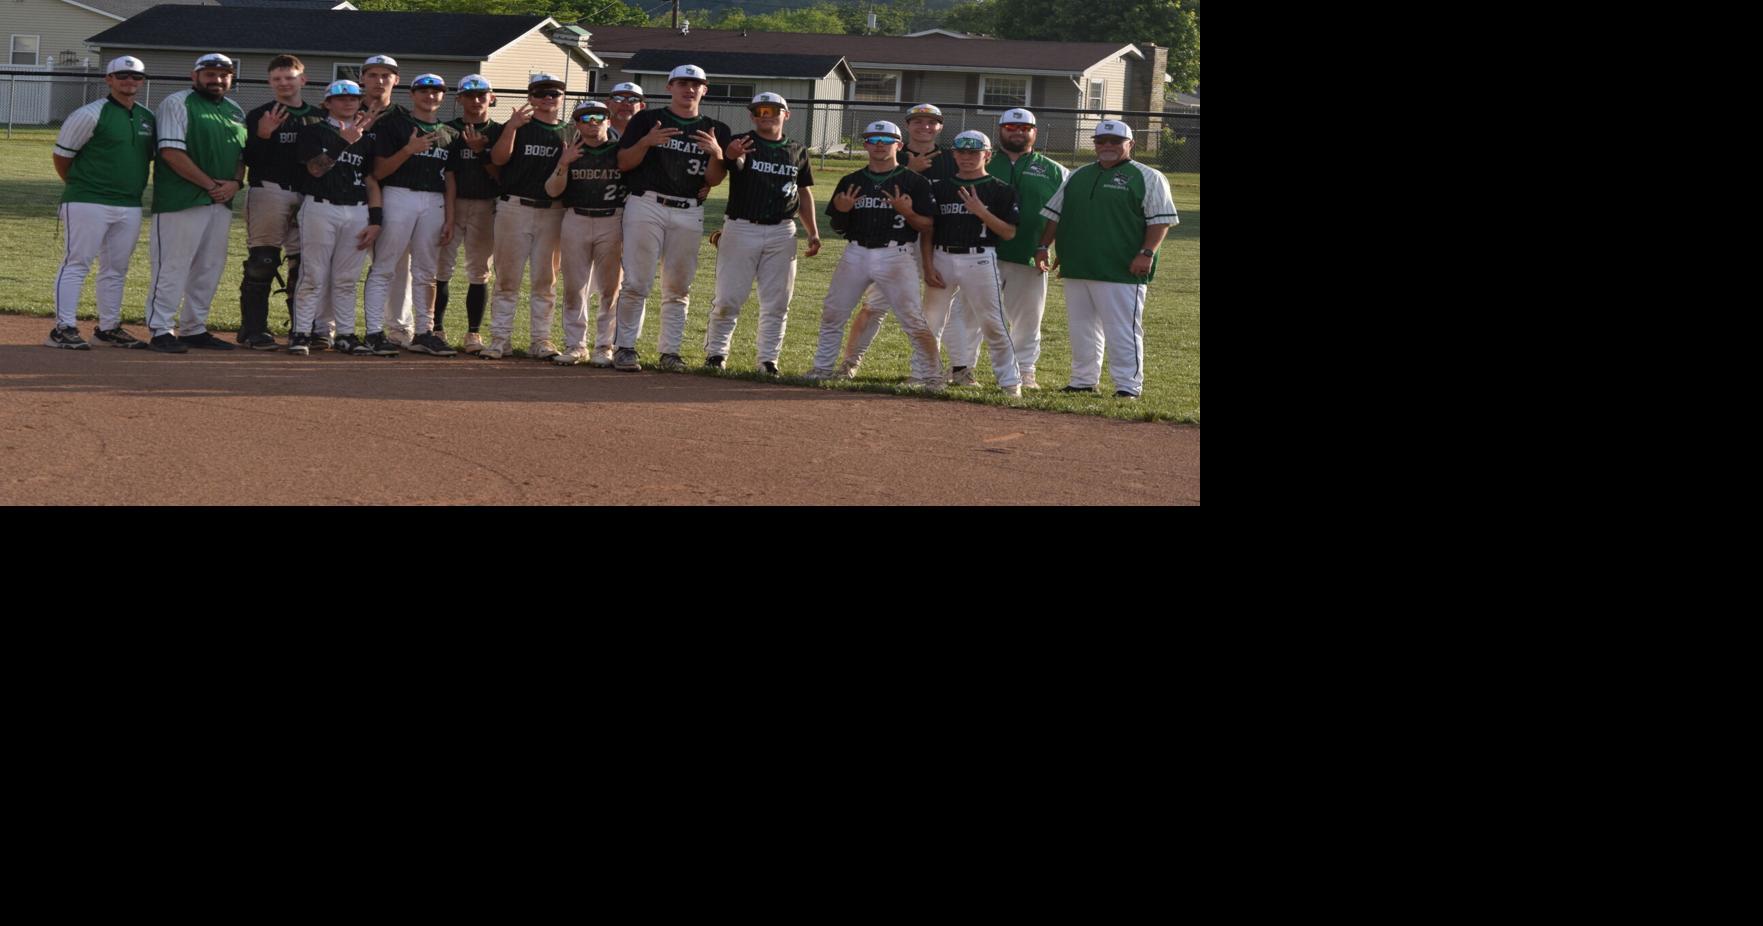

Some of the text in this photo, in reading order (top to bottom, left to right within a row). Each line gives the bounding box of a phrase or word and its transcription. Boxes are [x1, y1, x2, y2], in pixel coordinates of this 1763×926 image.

[656, 137, 705, 155] OBCAT
[337, 151, 364, 167] CATS
[414, 147, 449, 161] CATS
[571, 168, 622, 180] BOBCATS
[751, 159, 799, 177] BOBCATS
[940, 203, 969, 215] BOBC
[892, 214, 906, 229] 3
[979, 223, 987, 238] 1
